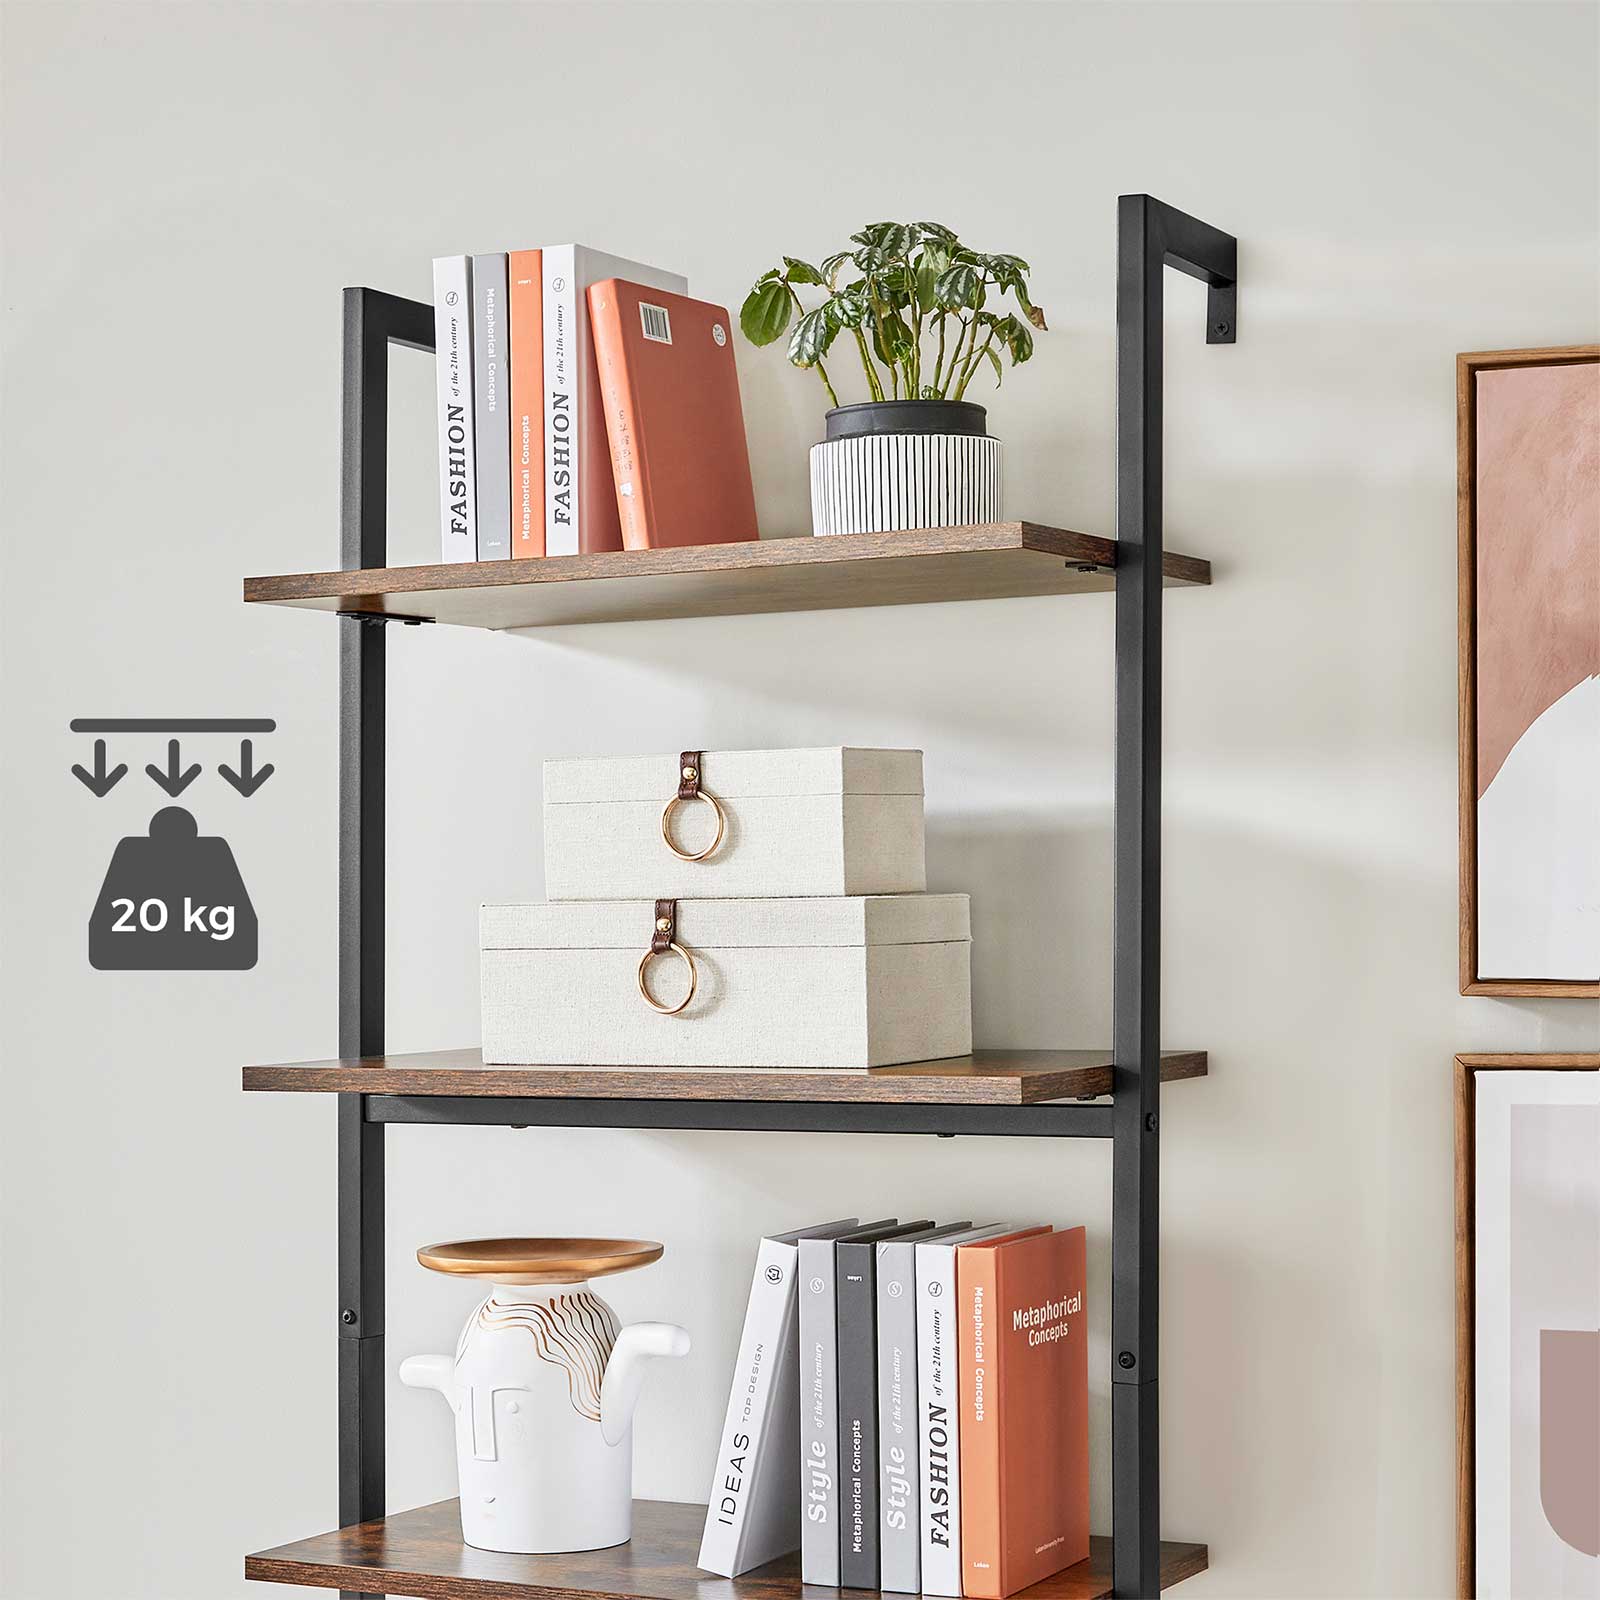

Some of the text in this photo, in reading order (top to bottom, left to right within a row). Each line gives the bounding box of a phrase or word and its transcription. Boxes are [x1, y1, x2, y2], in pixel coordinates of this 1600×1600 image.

[450, 317, 459, 348] century
[556, 304, 565, 335] century
[450, 349, 458, 368] 21th
[487, 288, 496, 412] Metaphorical Concepts
[556, 336, 564, 355] 21th
[453, 386, 459, 396] of
[559, 374, 565, 384] of
[448, 404, 467, 535] FASHION
[552, 391, 571, 526] FASHION
[521, 416, 530, 539] Metaphorical Concepts
[1013, 1292, 1081, 1331] Metaphorical
[1028, 1322, 1069, 1347] Concepts
[815, 1342, 824, 1375] century
[893, 1347, 903, 1379] century
[974, 1287, 984, 1421] Metaphorical Concepts
[718, 1343, 764, 1526] IDEAS TOP DESIGN
[817, 1415, 823, 1428] of
[896, 1420, 903, 1434] of
[928, 1309, 950, 1549] FASHION of the 21th century
[807, 1440, 831, 1523] Style
[852, 1420, 863, 1553] Metaphorical Concepts
[886, 1447, 911, 1530] Style
